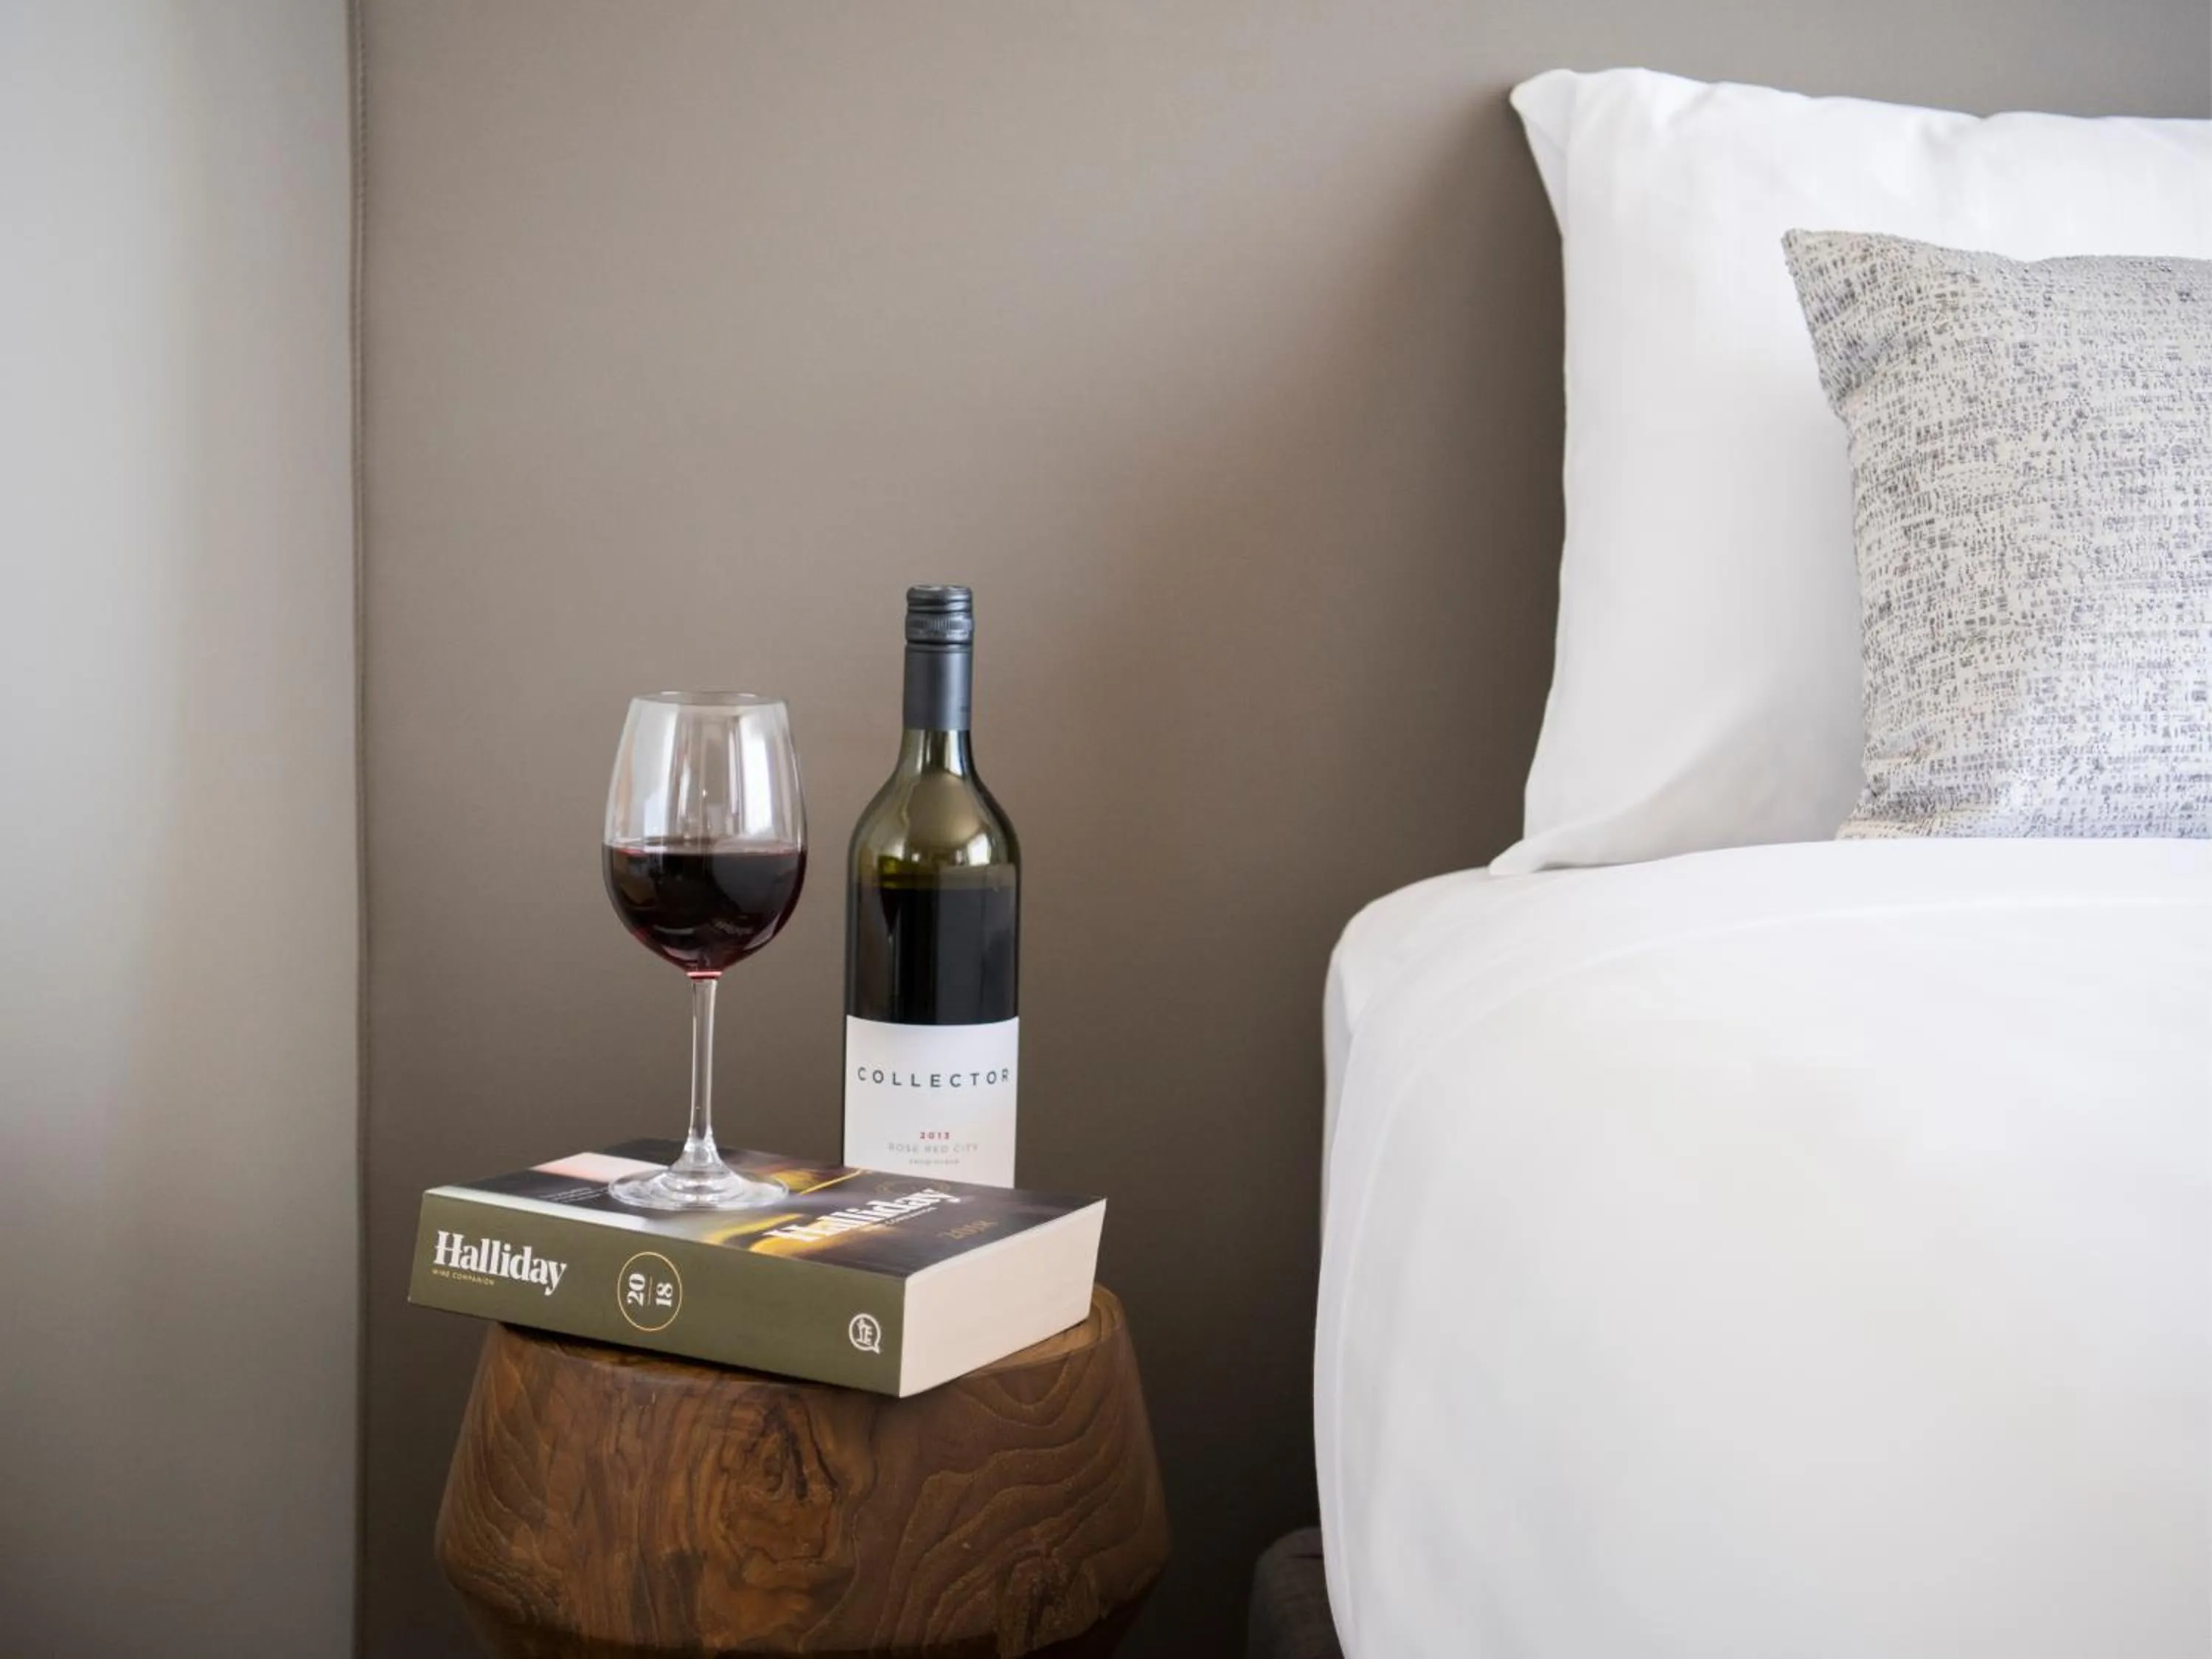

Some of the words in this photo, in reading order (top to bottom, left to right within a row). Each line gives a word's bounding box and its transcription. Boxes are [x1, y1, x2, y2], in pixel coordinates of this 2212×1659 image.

[858, 1066, 1009, 1088] COLLECTOR
[762, 1188, 961, 1242] Halliday
[434, 1229, 568, 1296] Halliday
[452, 1272, 495, 1286] COMPANION
[626, 1273, 646, 1307] 20
[655, 1282, 673, 1308] 18
